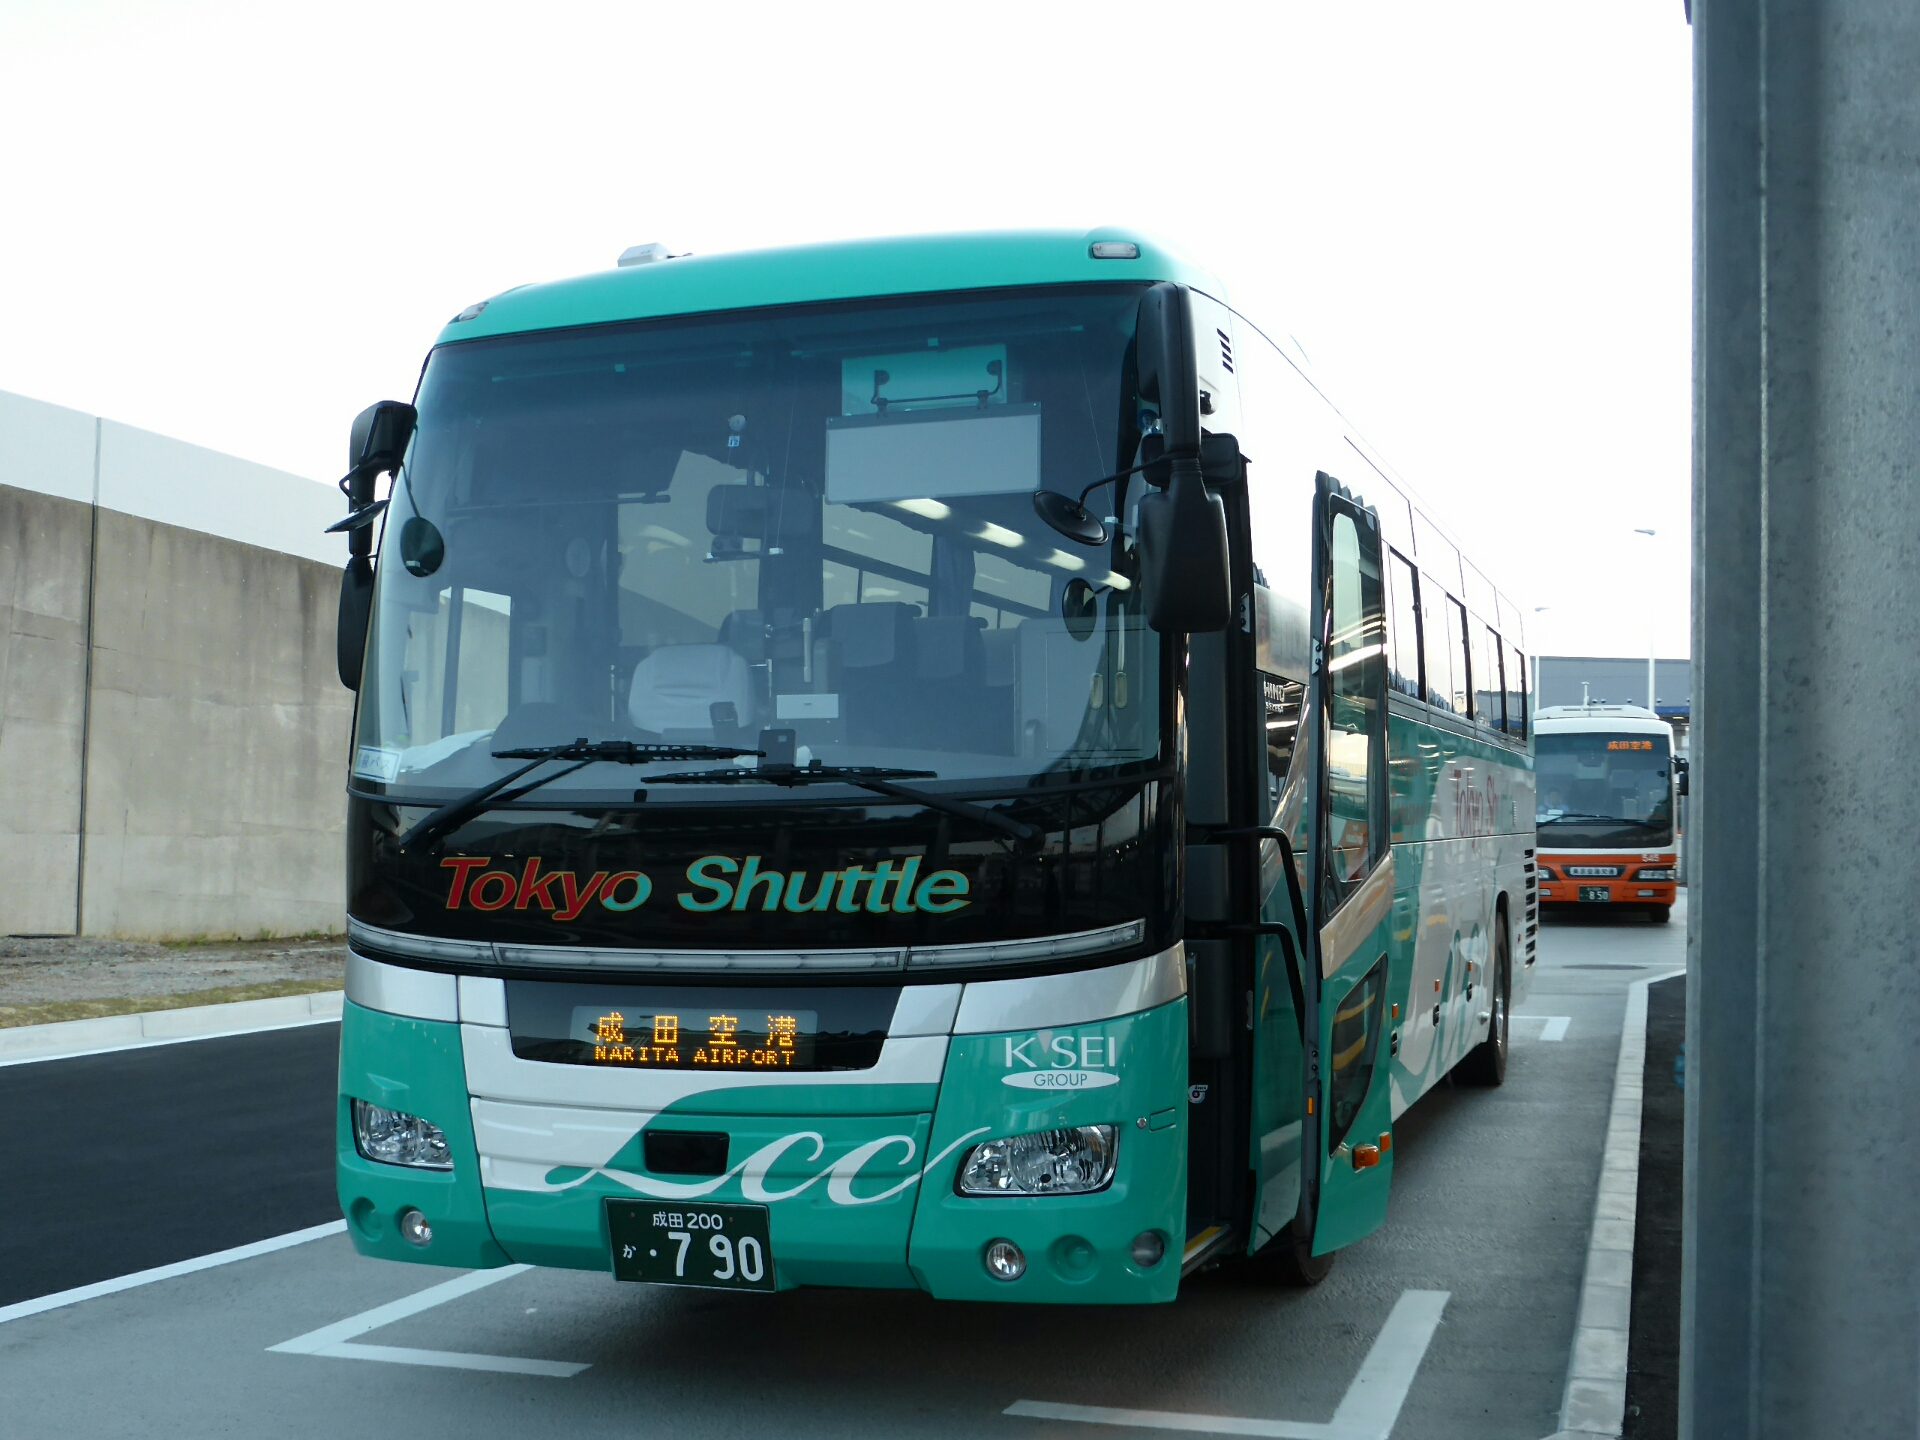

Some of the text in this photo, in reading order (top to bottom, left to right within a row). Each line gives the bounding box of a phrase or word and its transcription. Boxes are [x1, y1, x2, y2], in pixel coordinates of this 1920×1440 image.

[1263, 680, 1285, 702] HINO
[1607, 740, 1653, 751] 成田空港
[439, 854, 972, 921] Tokyo Shuttle
[595, 1011, 797, 1047] 成田空港
[594, 1045, 796, 1066] NARITA AIRPORT
[1033, 1072, 1088, 1087] GROUP
